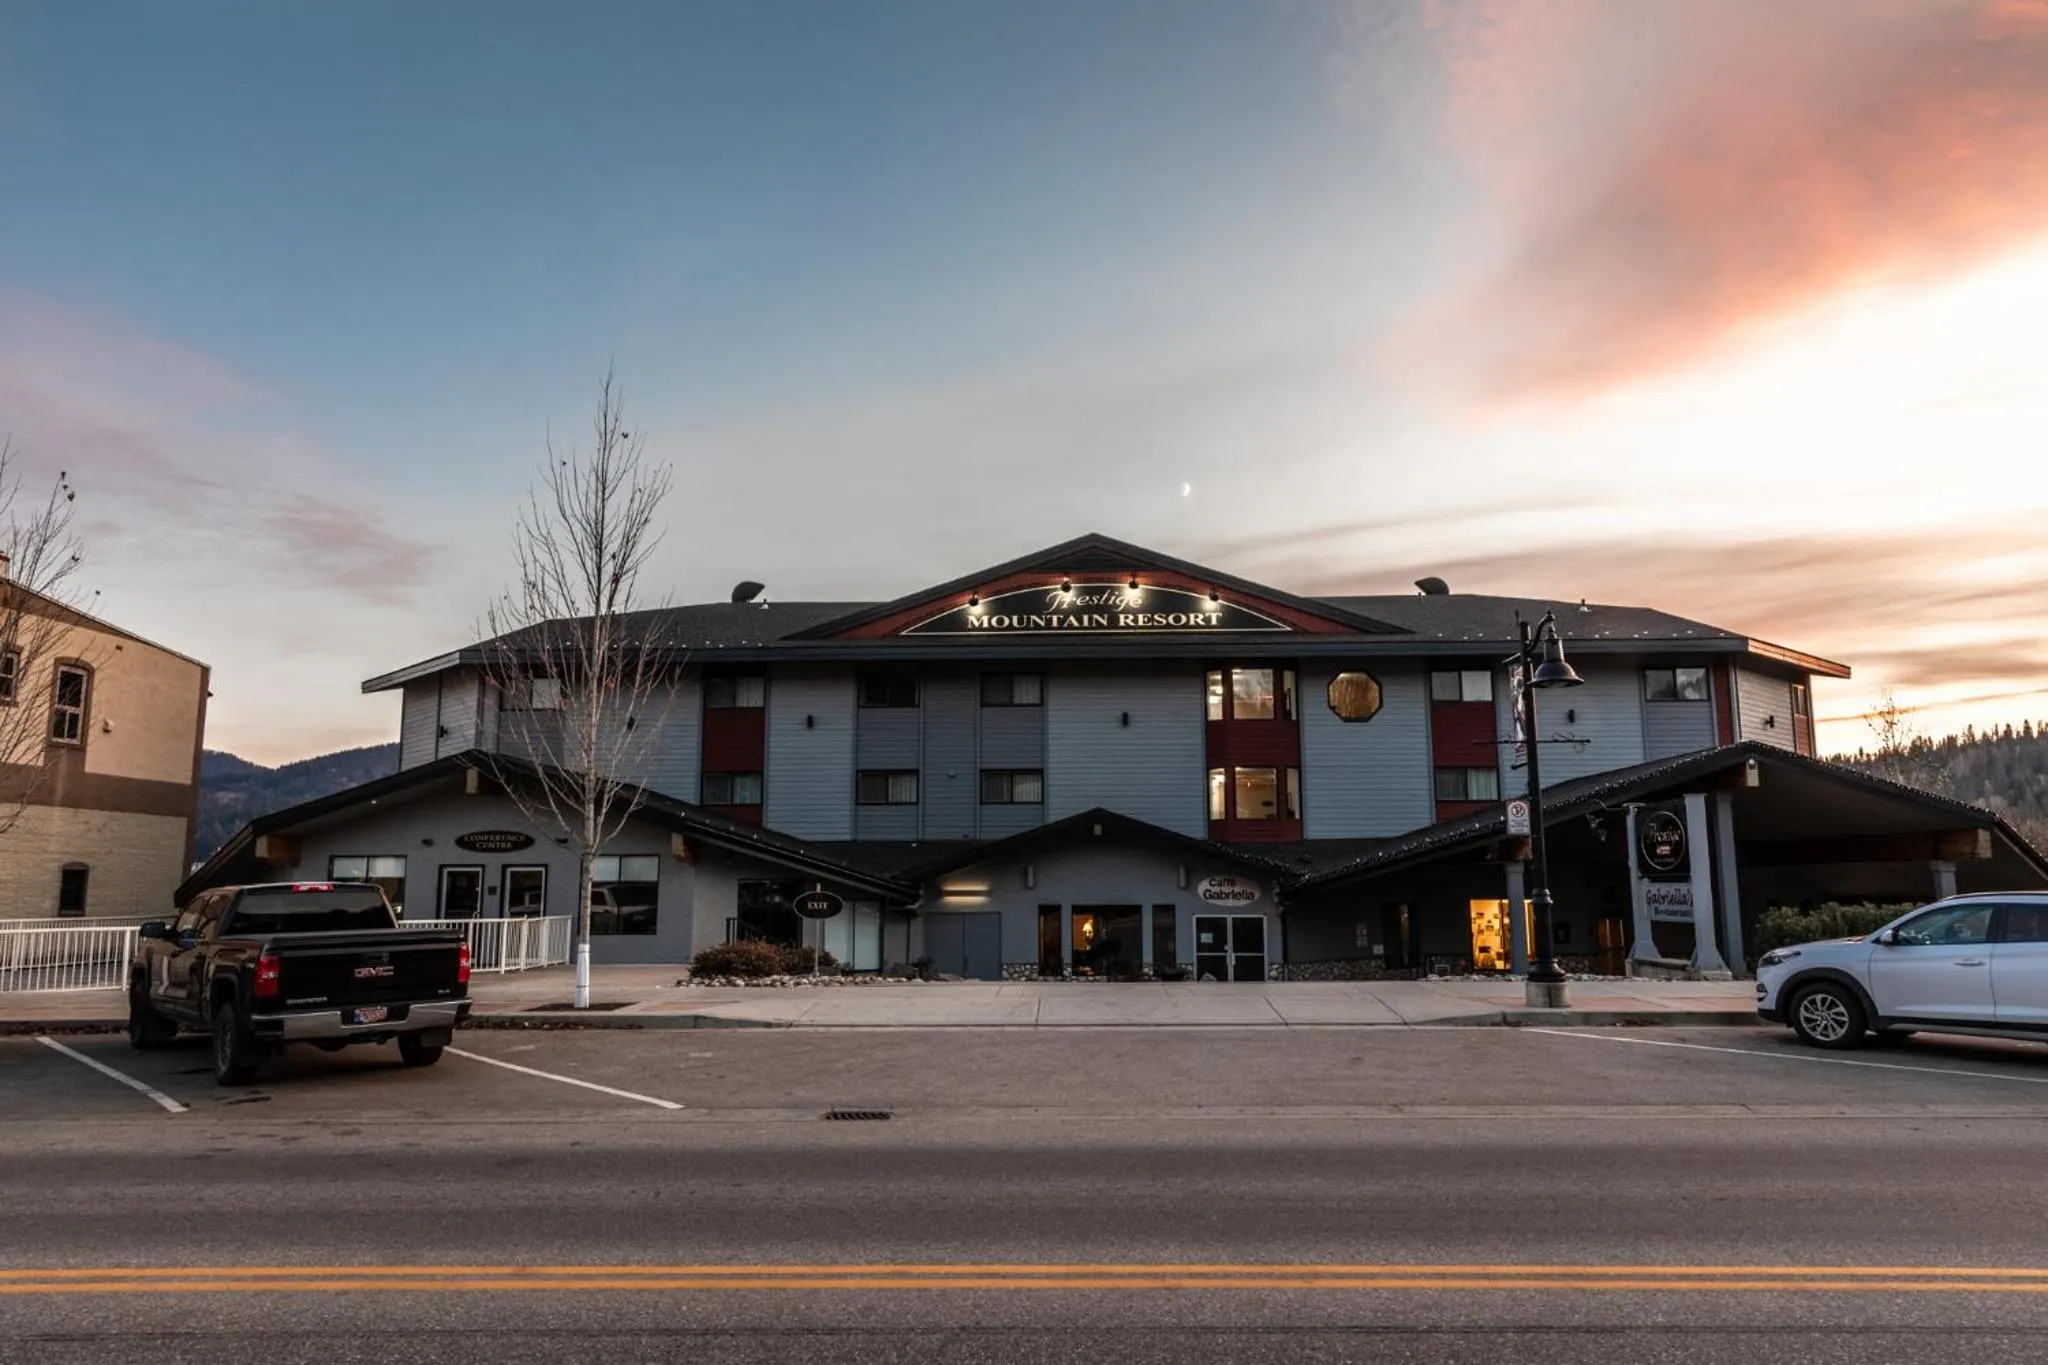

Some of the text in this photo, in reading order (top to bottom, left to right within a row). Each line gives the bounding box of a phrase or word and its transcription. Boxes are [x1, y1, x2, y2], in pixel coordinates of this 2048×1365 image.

[1044, 589, 1143, 613] Prestige
[967, 612, 1223, 629] MOUNTAIN RESORT
[463, 834, 527, 842] CONFERENCE
[475, 841, 513, 849] CENTRE
[1203, 888, 1255, 900] Gabriella
[807, 901, 828, 910] EXIT
[354, 965, 395, 979] GMC
